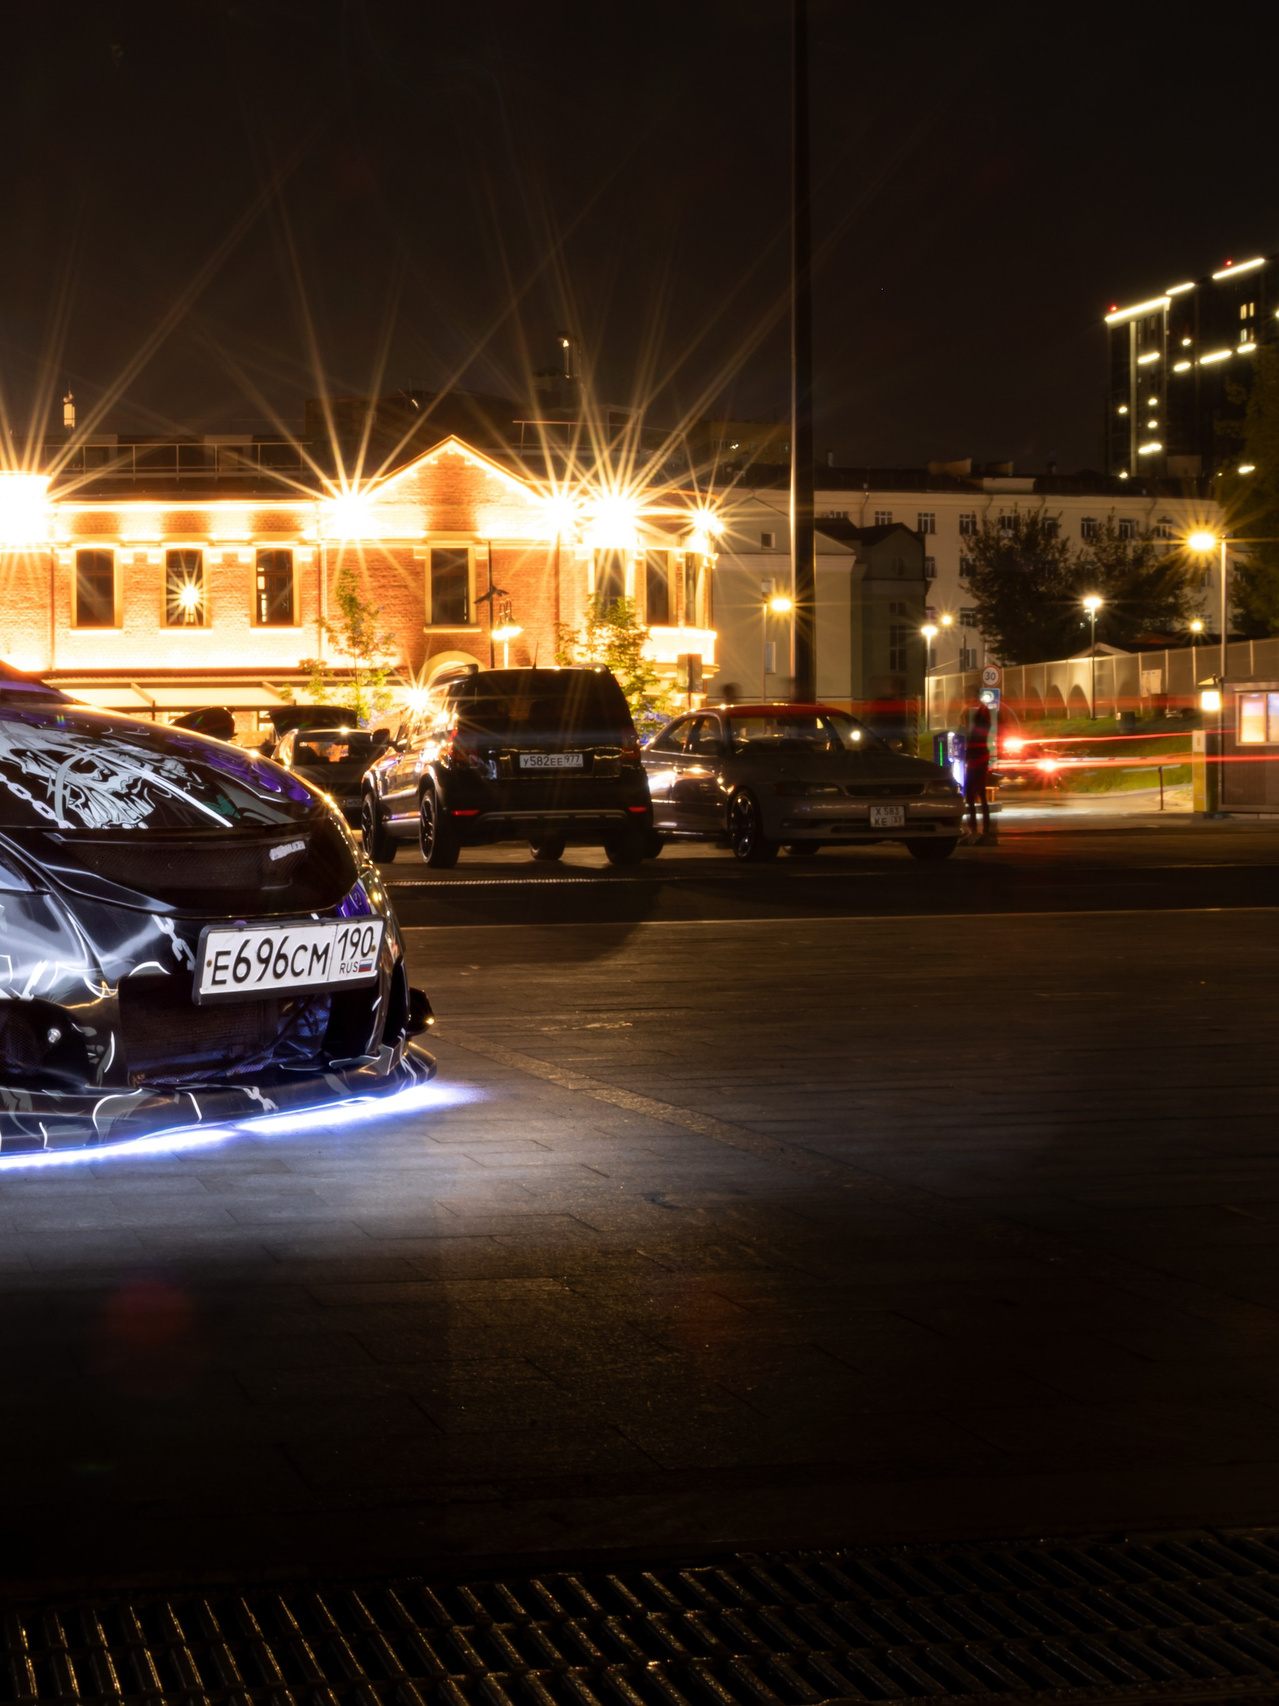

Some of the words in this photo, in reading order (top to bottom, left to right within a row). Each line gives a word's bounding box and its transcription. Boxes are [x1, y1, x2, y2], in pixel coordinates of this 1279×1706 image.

[985, 672, 996, 681] 30
[211, 936, 330, 985] Е696СМ
[337, 926, 374, 961] 190
[339, 961, 359, 975] RUS
